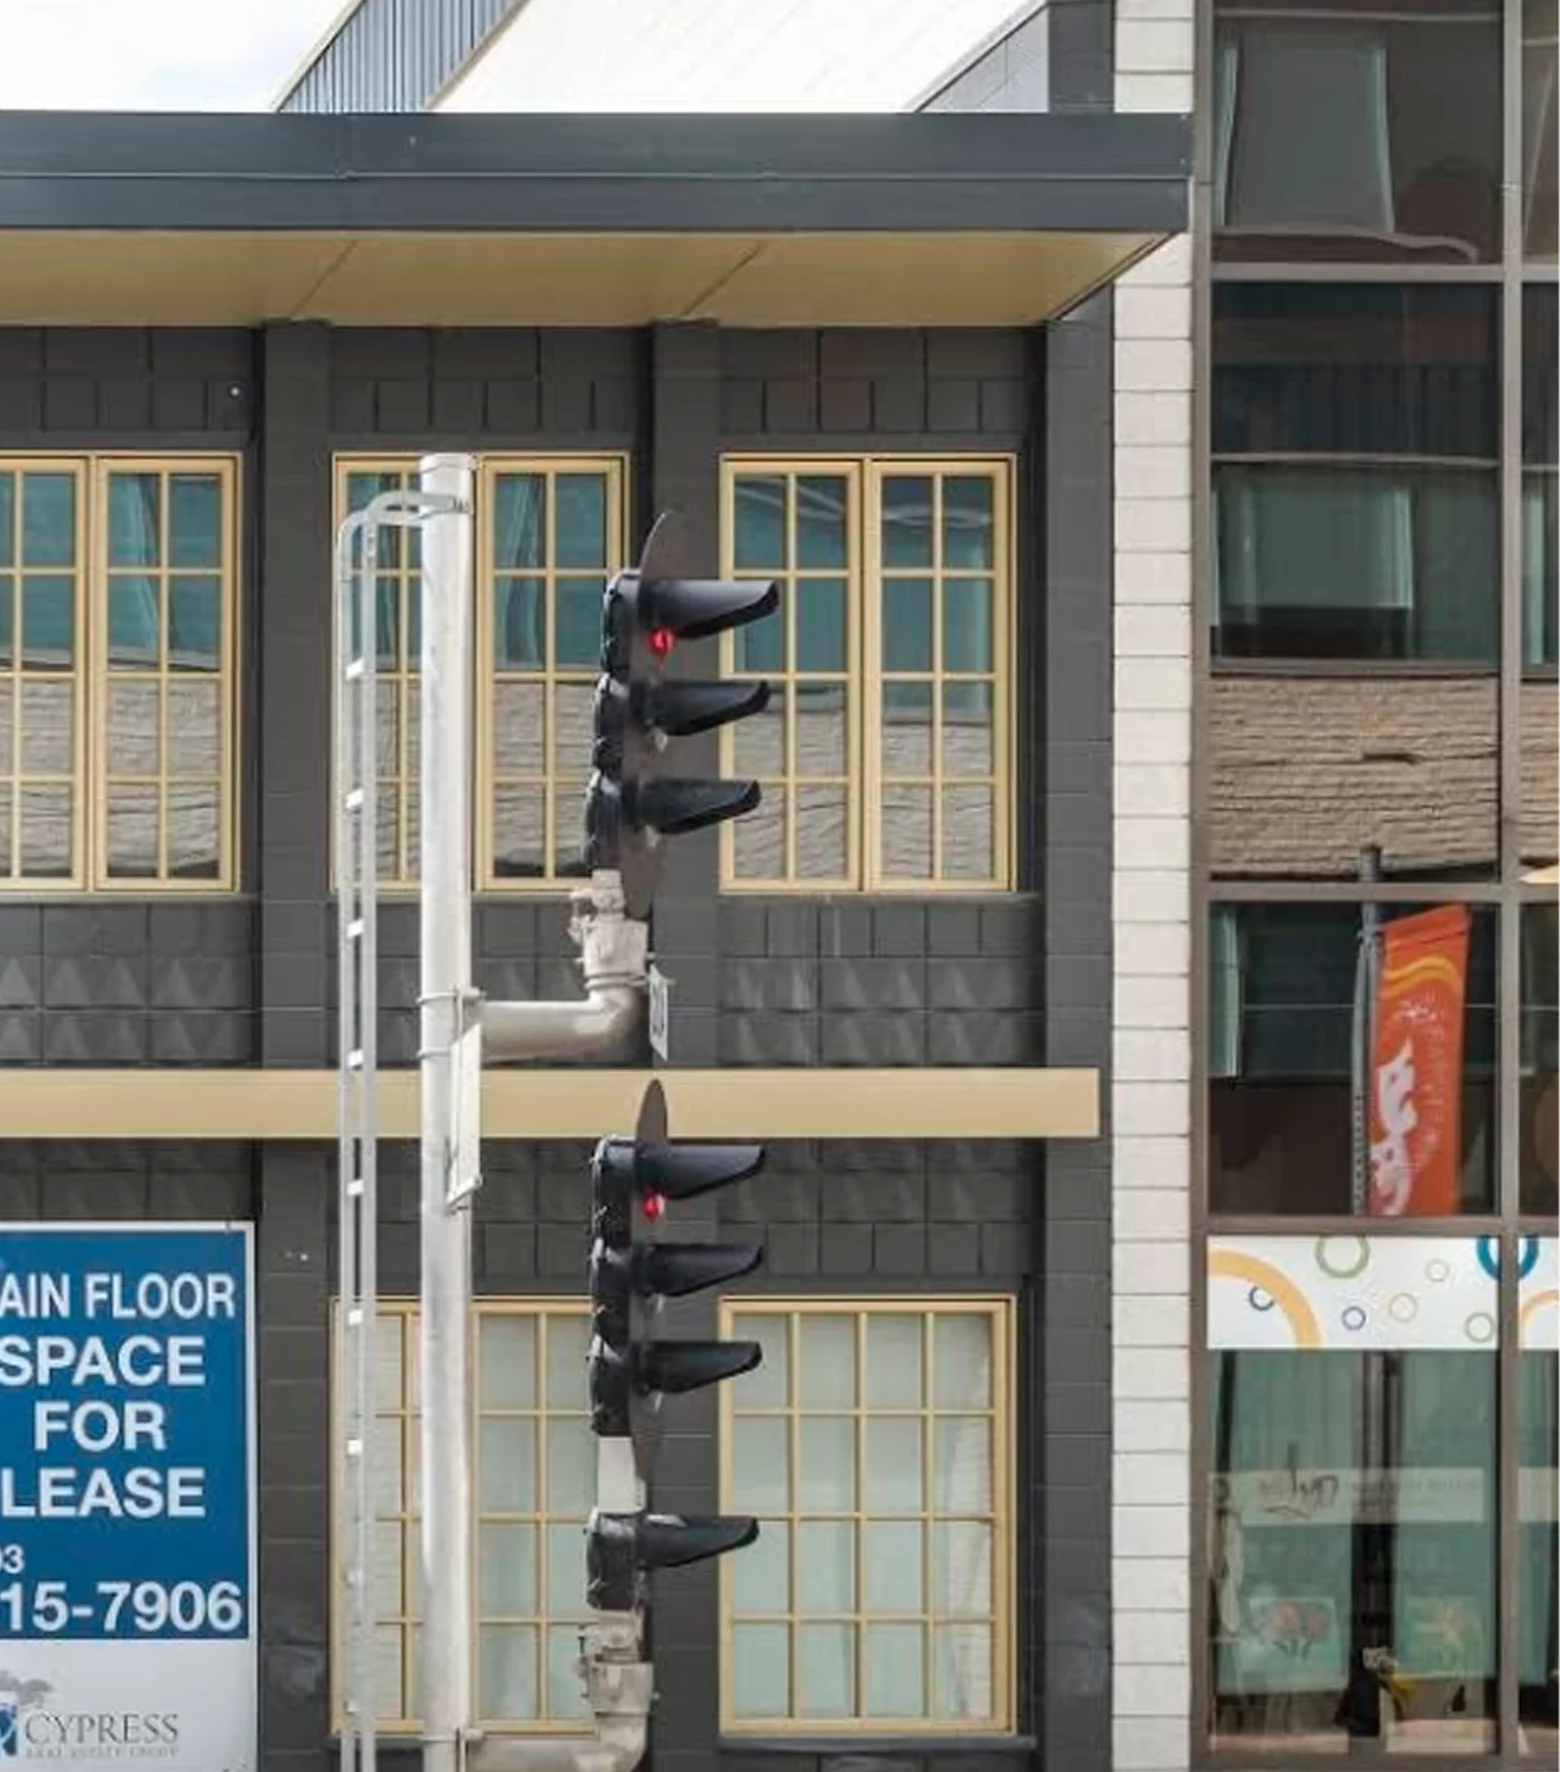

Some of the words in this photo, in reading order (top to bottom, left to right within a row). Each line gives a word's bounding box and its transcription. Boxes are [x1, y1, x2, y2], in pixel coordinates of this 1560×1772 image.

[85, 1272, 236, 1320] FLOOR
[34, 1400, 166, 1453] FOR
[0, 1466, 206, 1519] LEASE
[25, 1712, 179, 1745] CYPRESS
